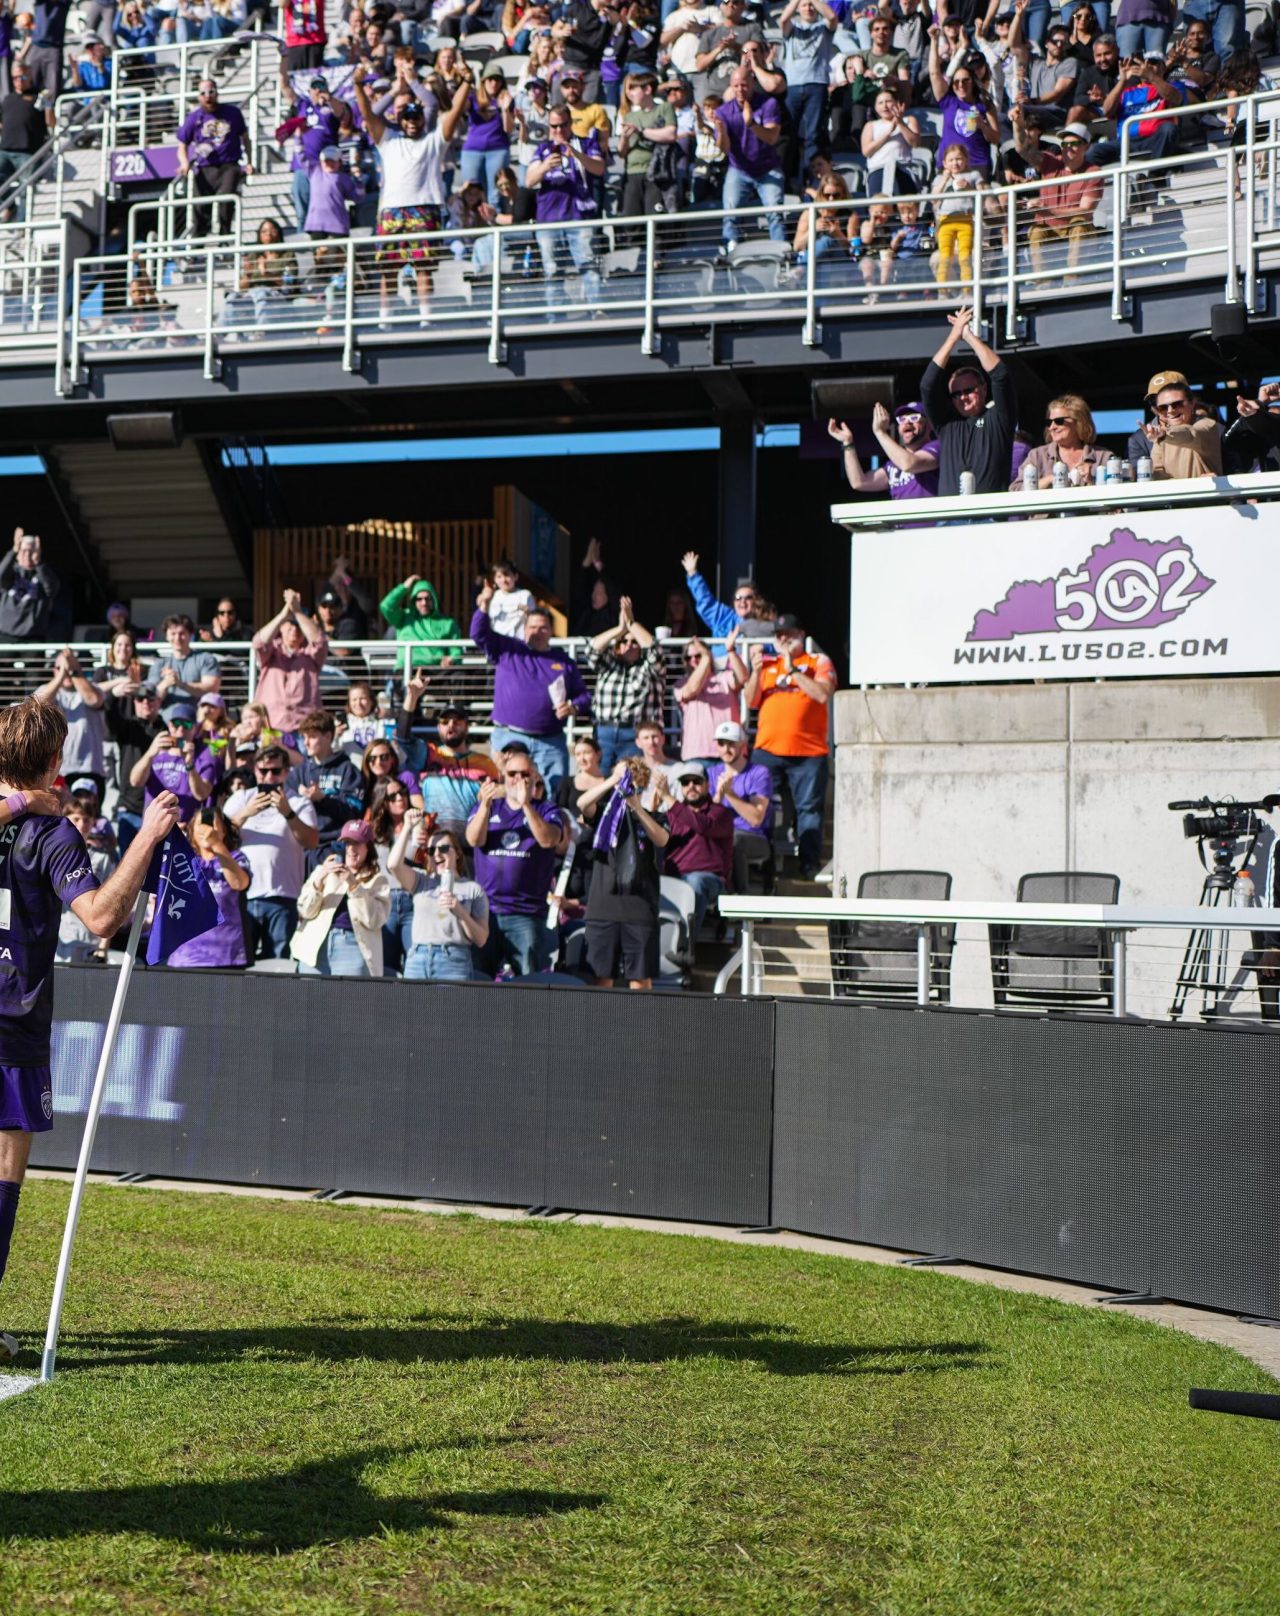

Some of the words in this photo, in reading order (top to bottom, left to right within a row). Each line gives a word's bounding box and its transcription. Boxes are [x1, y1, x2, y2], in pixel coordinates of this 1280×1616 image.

[115, 153, 146, 176] 220
[953, 637, 1229, 665] WWW.LU502.COM
[172, 852, 198, 885] CITY
